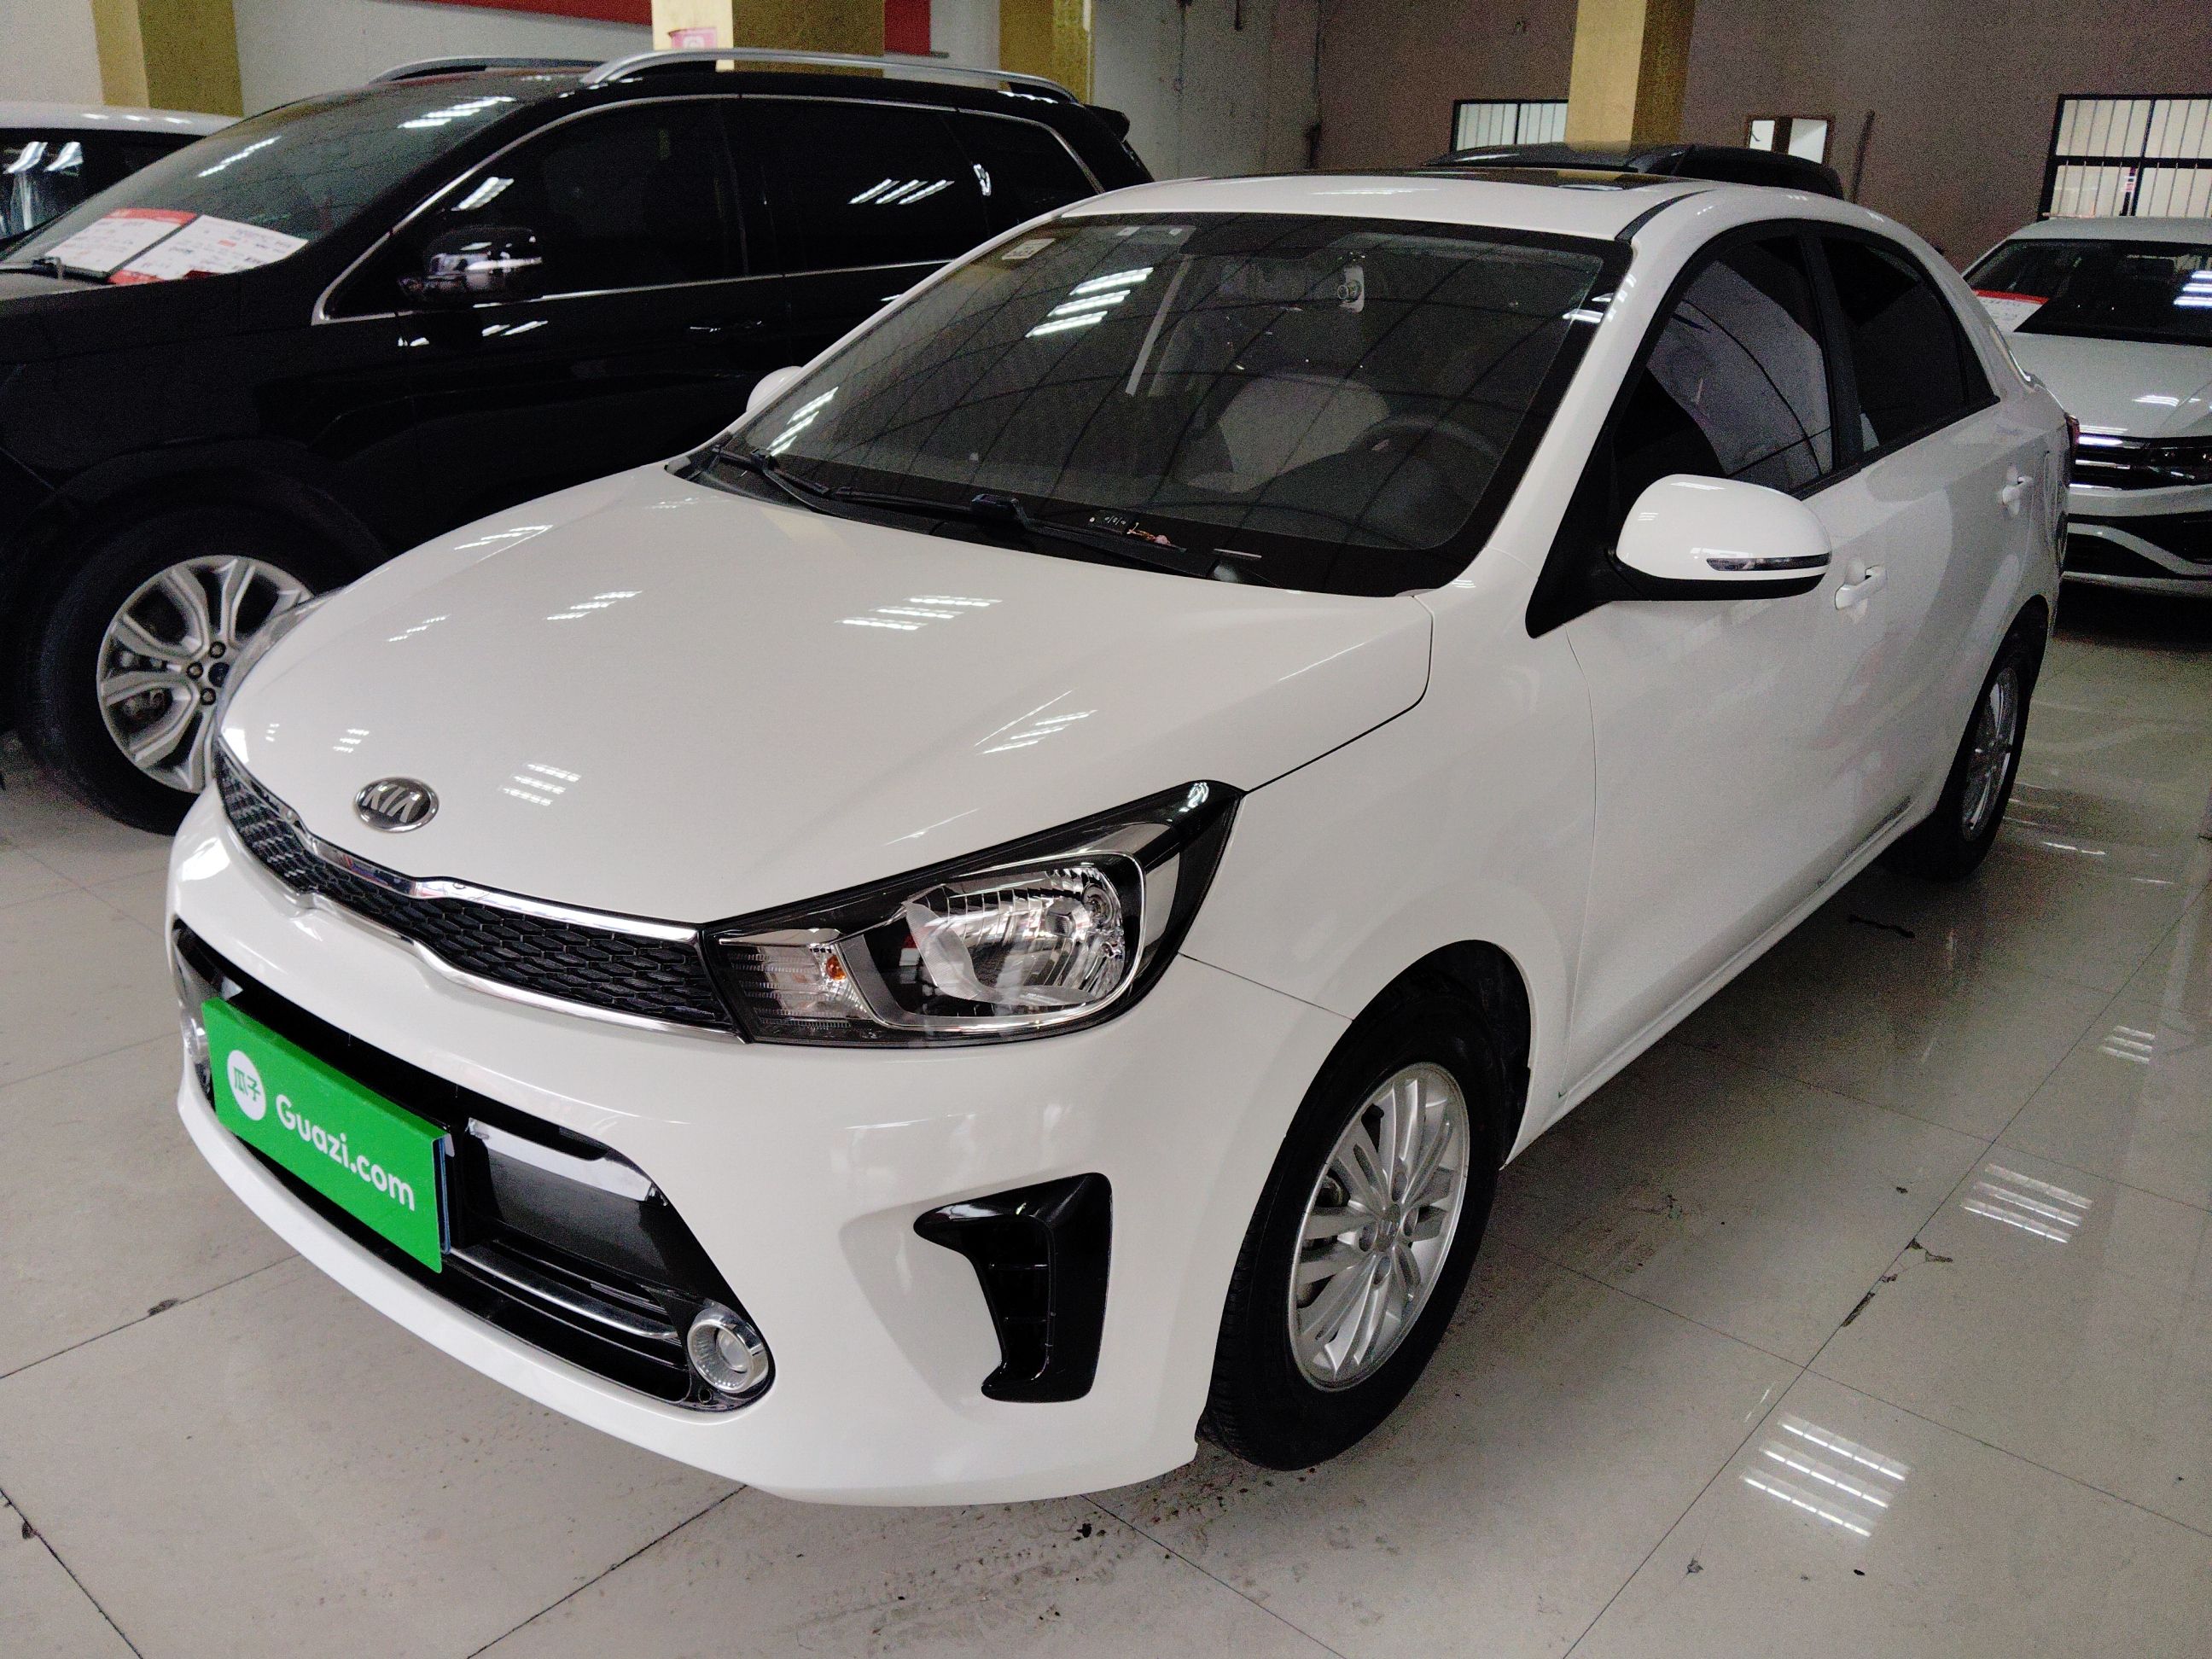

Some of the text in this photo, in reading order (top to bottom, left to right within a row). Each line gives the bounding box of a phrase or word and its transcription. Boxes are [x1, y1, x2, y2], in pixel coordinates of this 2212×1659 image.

[361, 781, 422, 824] KIA
[233, 1066, 261, 1101] 瓜子
[276, 1094, 415, 1212] Guazi.com
